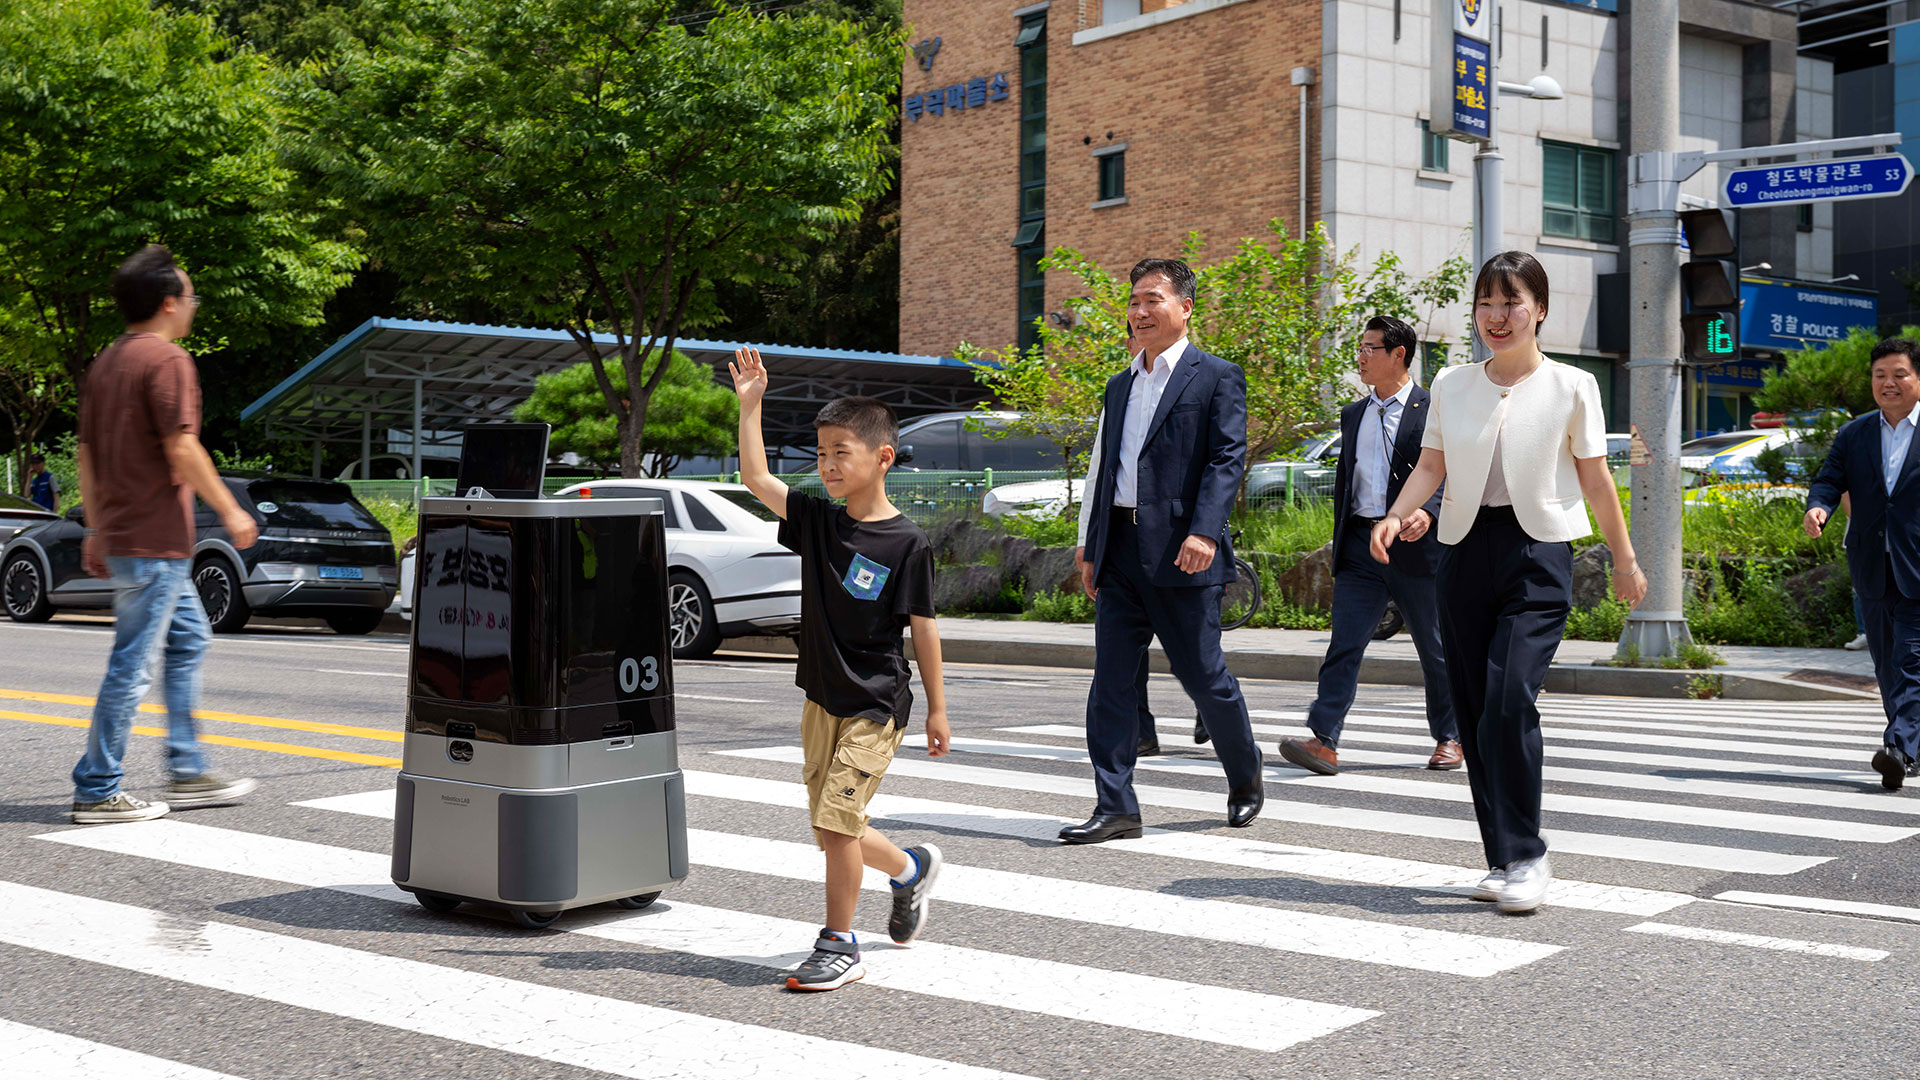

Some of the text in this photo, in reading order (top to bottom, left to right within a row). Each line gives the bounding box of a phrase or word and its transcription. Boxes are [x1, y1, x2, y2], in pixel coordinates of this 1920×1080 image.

[905, 74, 1009, 122] 부곡파출소
[1456, 85, 1487, 110] 파출소
[1766, 163, 1863, 187] 철도박물관로
[1884, 168, 1900, 181] 53
[1732, 182, 1748, 193] 49
[1758, 183, 1874, 201] Cheoldobangmulgwan-ro
[1770, 313, 1798, 334] 경찰
[1802, 323, 1839, 338] POLICE
[1707, 318, 1734, 354] 16
[619, 656, 659, 693] 03
